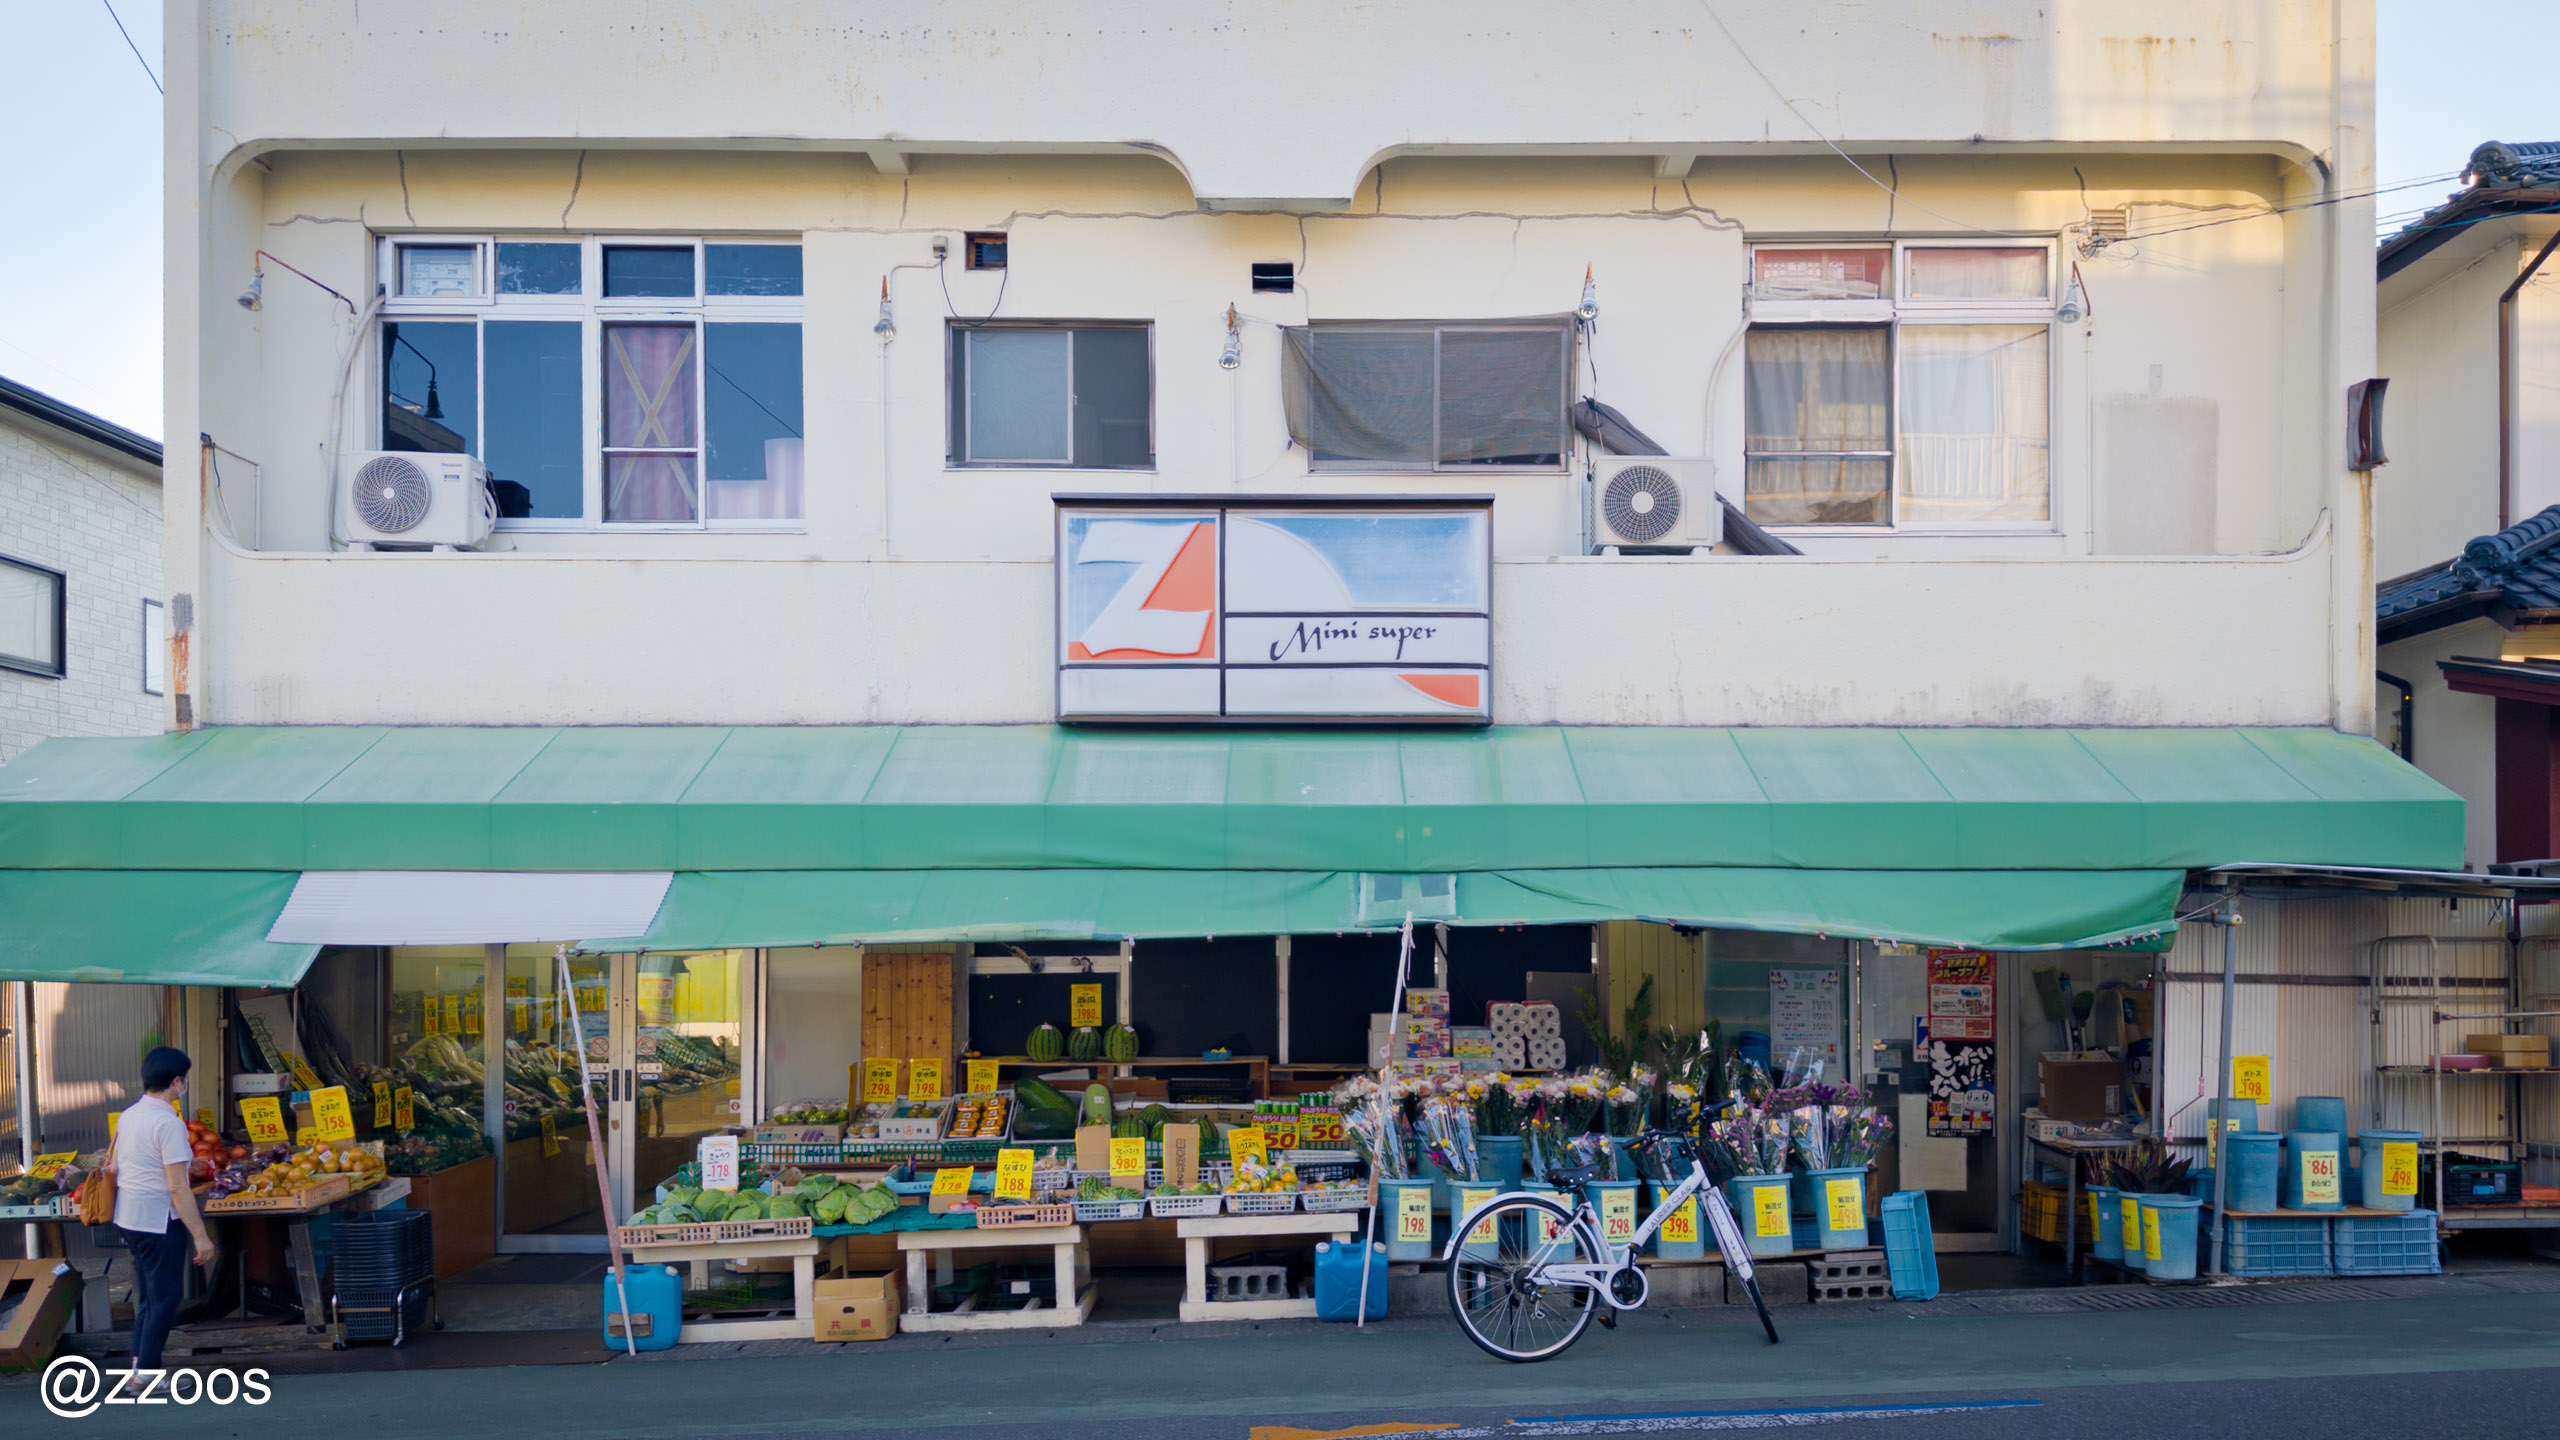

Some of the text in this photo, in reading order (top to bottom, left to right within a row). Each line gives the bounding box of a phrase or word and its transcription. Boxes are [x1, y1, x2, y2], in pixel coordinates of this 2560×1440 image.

[1269, 621, 1437, 661] Mini super
[1077, 1008, 1096, 1020] 1980
[871, 1083, 890, 1095] 298
[915, 1082, 935, 1095] 198
[974, 1083, 991, 1094] 480
[2242, 1082, 2262, 1096] 198
[254, 1123, 278, 1135] 78
[323, 1115, 346, 1132] 158
[1311, 1124, 1345, 1140] 50
[1264, 1132, 1296, 1148] 50
[711, 1164, 729, 1177] 178
[1003, 1163, 1027, 1172] なすび
[1116, 1158, 1138, 1169] 980
[2312, 1159, 2334, 1176] 198
[1003, 1177, 1025, 1191] 188
[2391, 1170, 2412, 1186] 498
[940, 1182, 962, 1191] 178
[1764, 1215, 1784, 1231] 498
[1838, 1208, 1858, 1224] 498
[1404, 1216, 1425, 1233] 198
[1609, 1218, 1630, 1234] 298
[1668, 1217, 1689, 1233] 398
